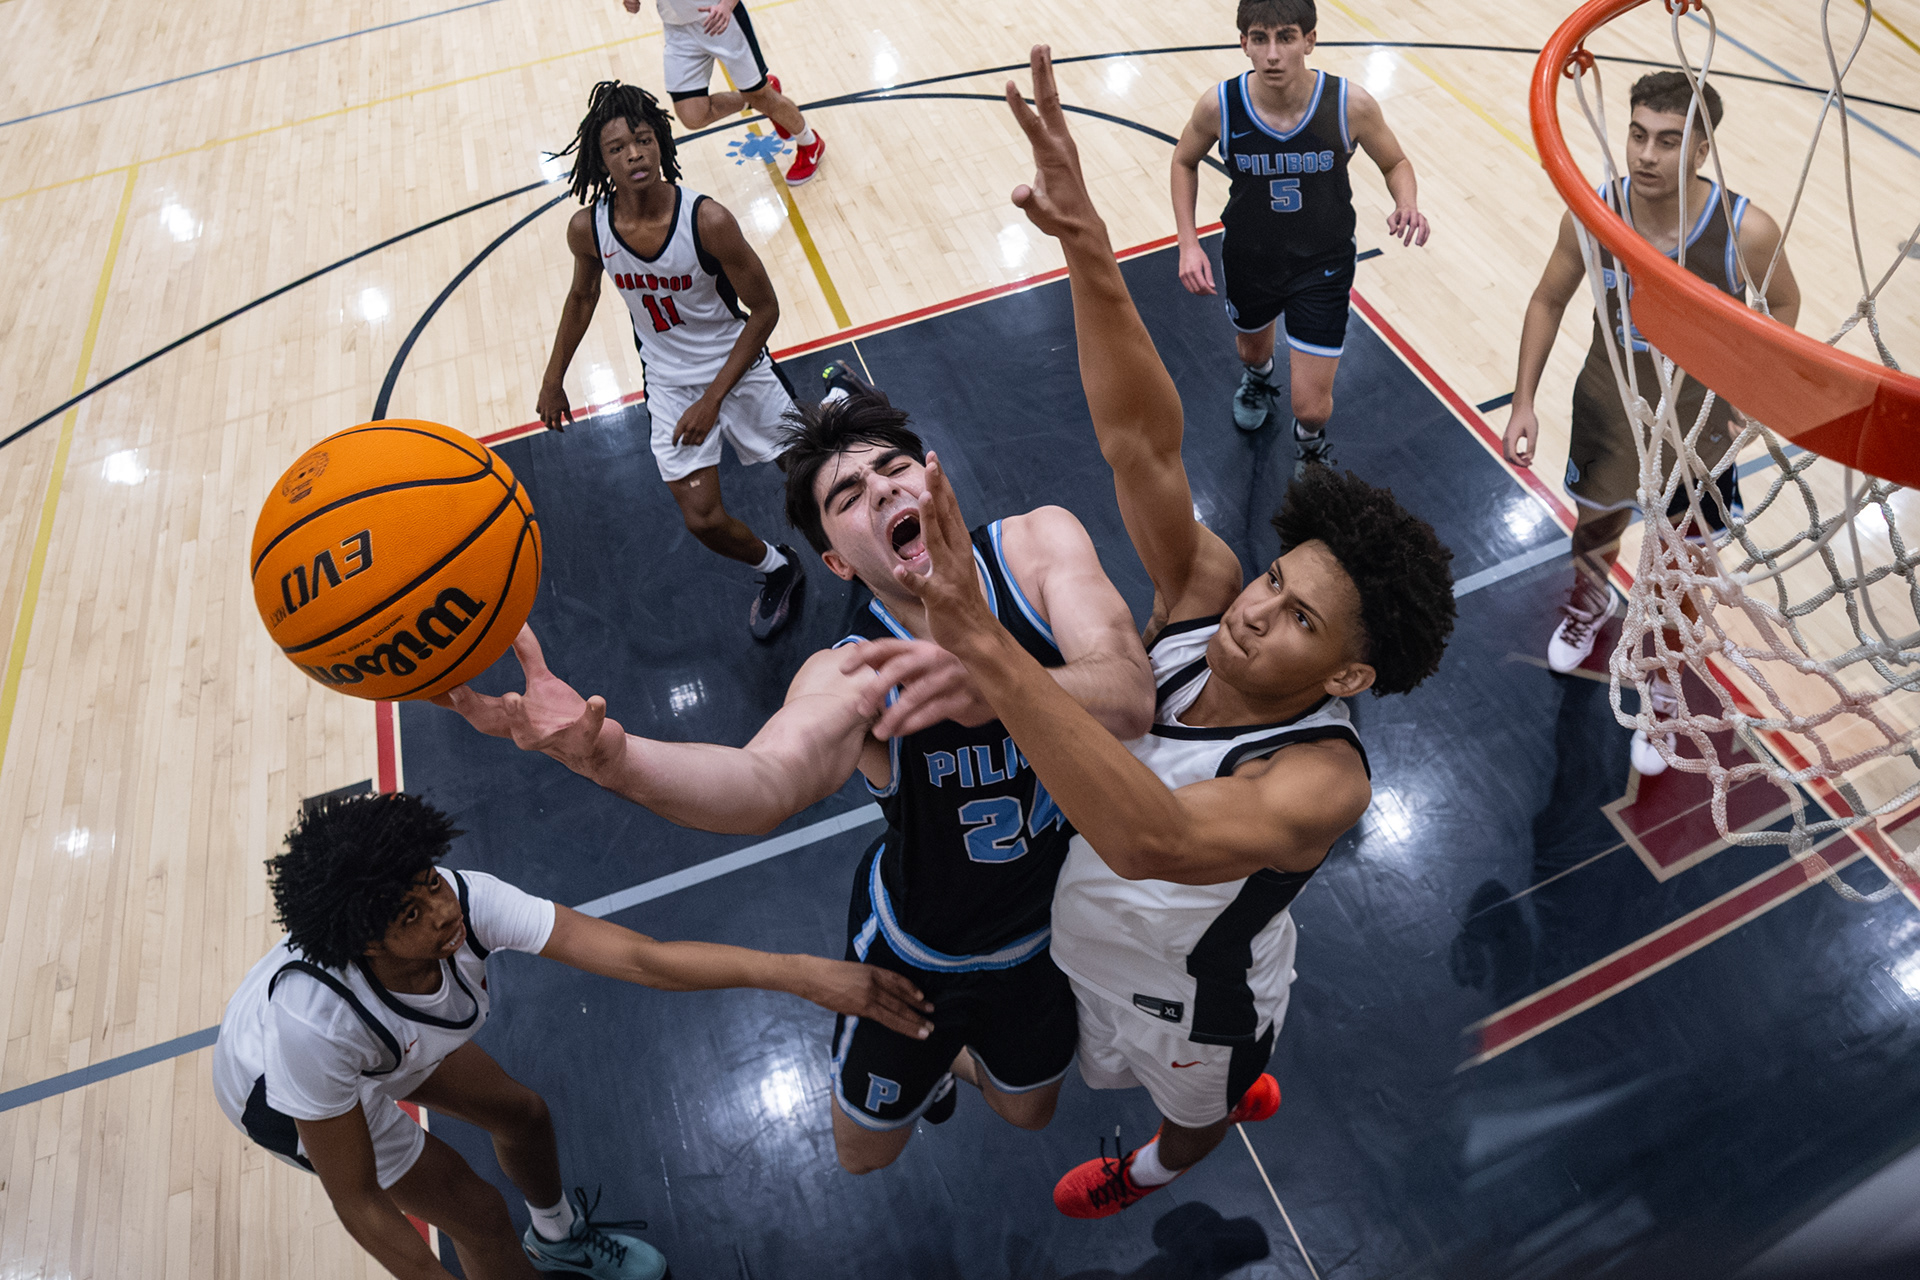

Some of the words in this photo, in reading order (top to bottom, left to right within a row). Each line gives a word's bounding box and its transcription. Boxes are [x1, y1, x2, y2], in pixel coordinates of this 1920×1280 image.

[1234, 150, 1334, 176] PILIBOS
[1269, 178, 1302, 213] 5
[615, 272, 692, 292] OAKWOOD
[641, 293, 687, 333] 11
[281, 529, 373, 615] EVO
[299, 587, 487, 686] Wilson
[923, 735, 1031, 788] PILI
[1164, 1006, 1178, 1018] XL
[865, 1072, 902, 1113] P
